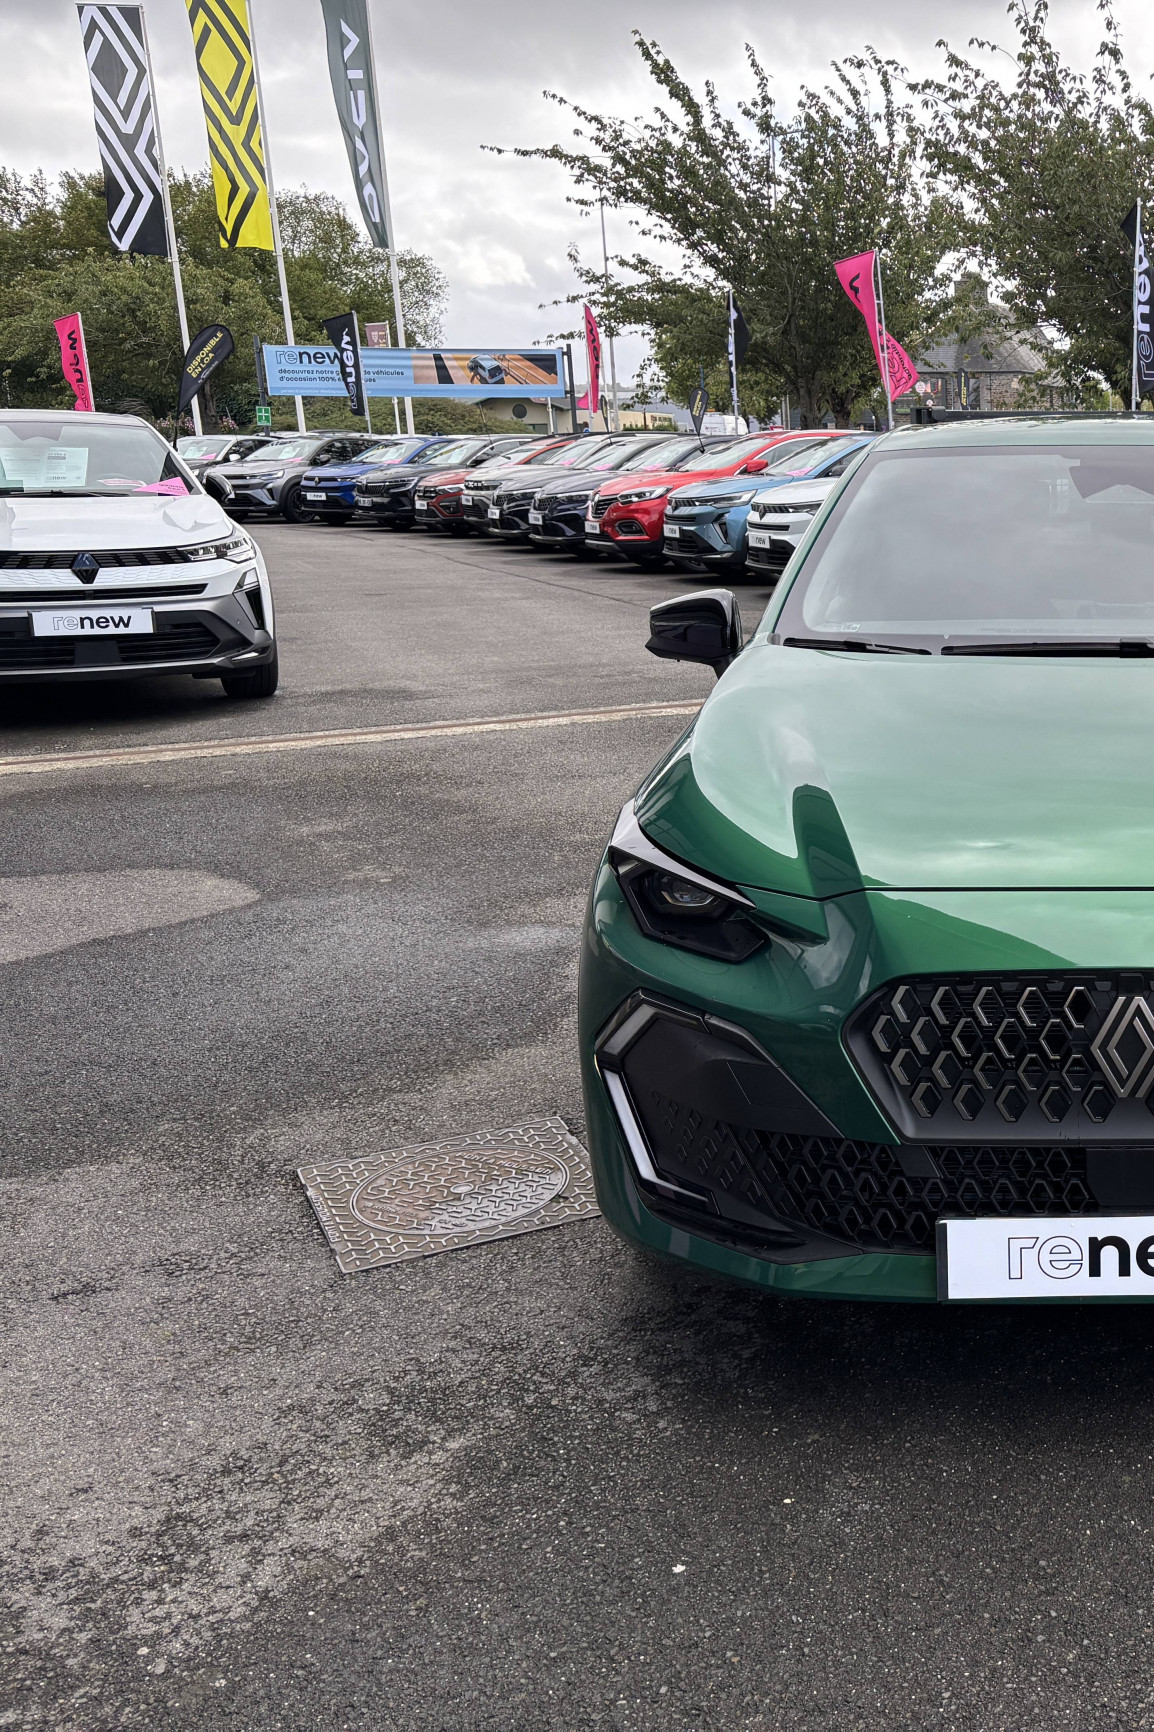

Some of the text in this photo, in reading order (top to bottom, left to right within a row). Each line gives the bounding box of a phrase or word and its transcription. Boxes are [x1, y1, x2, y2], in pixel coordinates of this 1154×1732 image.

[187, 331, 223, 373] DISPONIBLE
[191, 366, 202, 378] EN
[200, 353, 215, 368] LOA
[52, 615, 132, 630] renew
